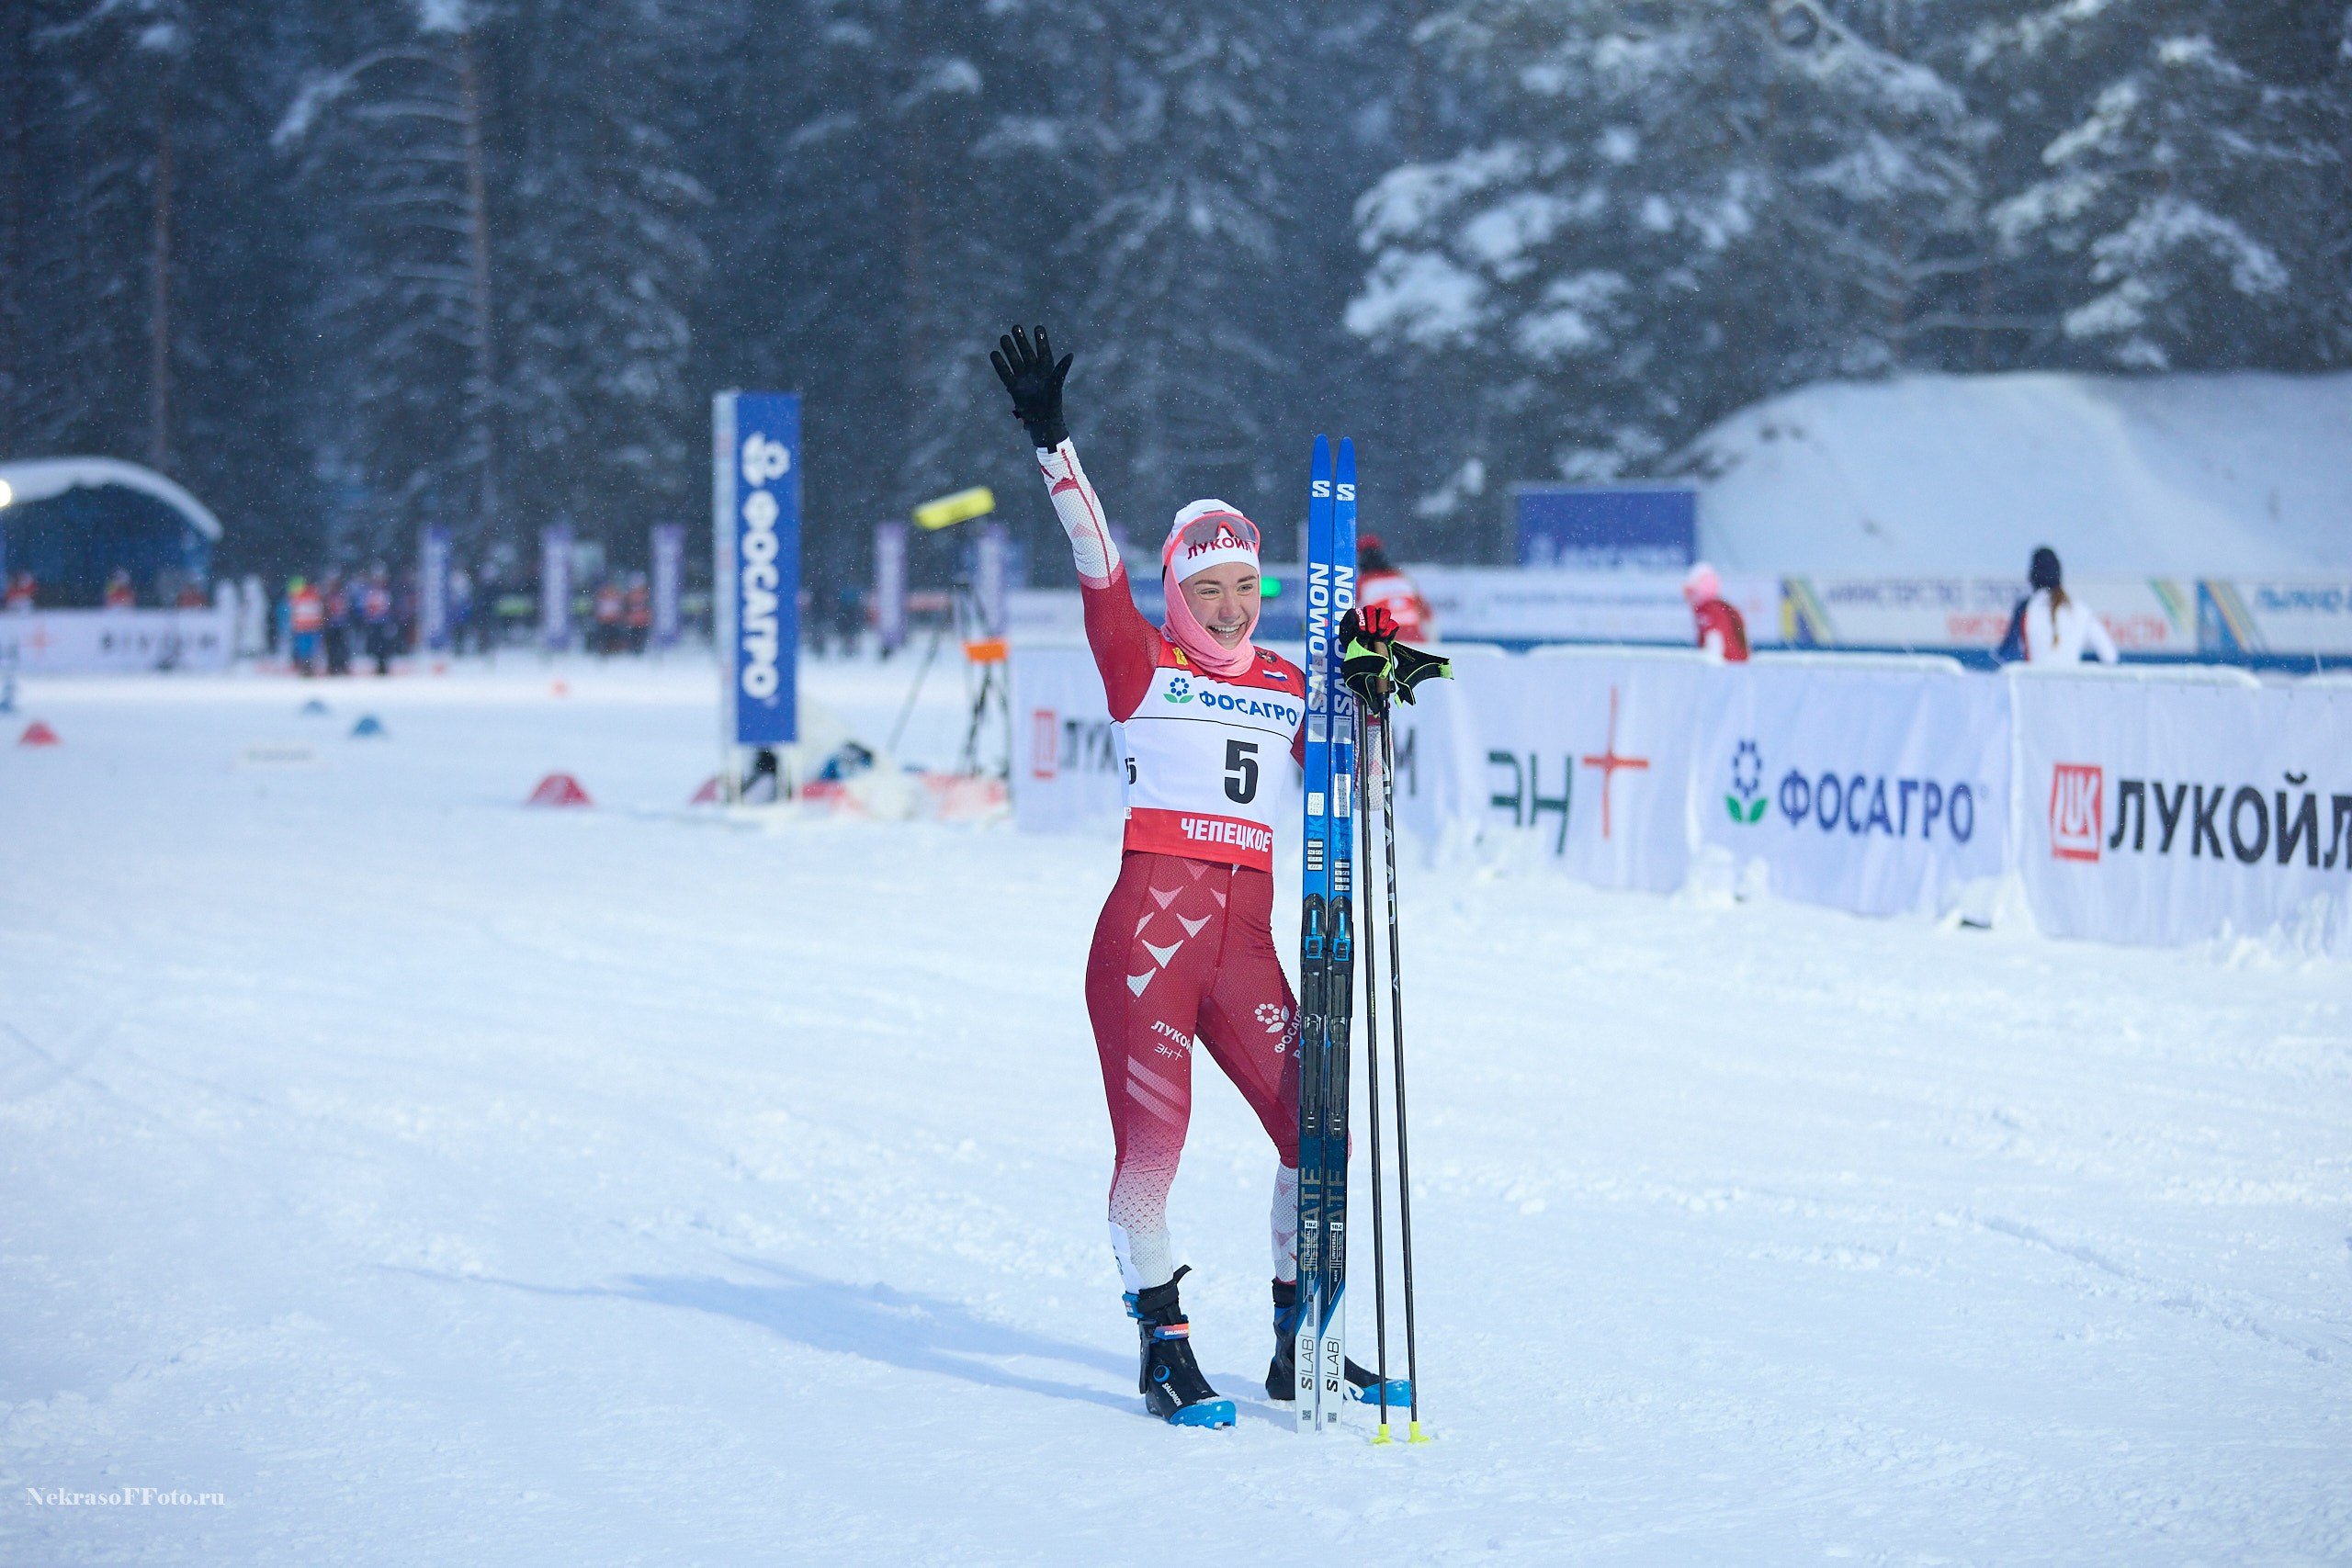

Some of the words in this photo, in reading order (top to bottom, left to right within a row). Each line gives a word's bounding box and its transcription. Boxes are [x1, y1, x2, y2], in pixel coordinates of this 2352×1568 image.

[1312, 480, 1330, 498] S
[1337, 483, 1355, 502] S
[741, 490, 780, 700] ФОСАГРО
[1308, 562, 1329, 715] SALOMON
[1198, 691, 1298, 727] ФОСАГРО
[1225, 739, 1259, 805] 5
[1779, 768, 1975, 844] ФОСАГРО
[2108, 771, 2352, 872] ЛУКОЙЛ
[1181, 818, 1273, 853] ЧЕПЕЦКОЕ
[1161, 1382, 1183, 1407] SALOMON
